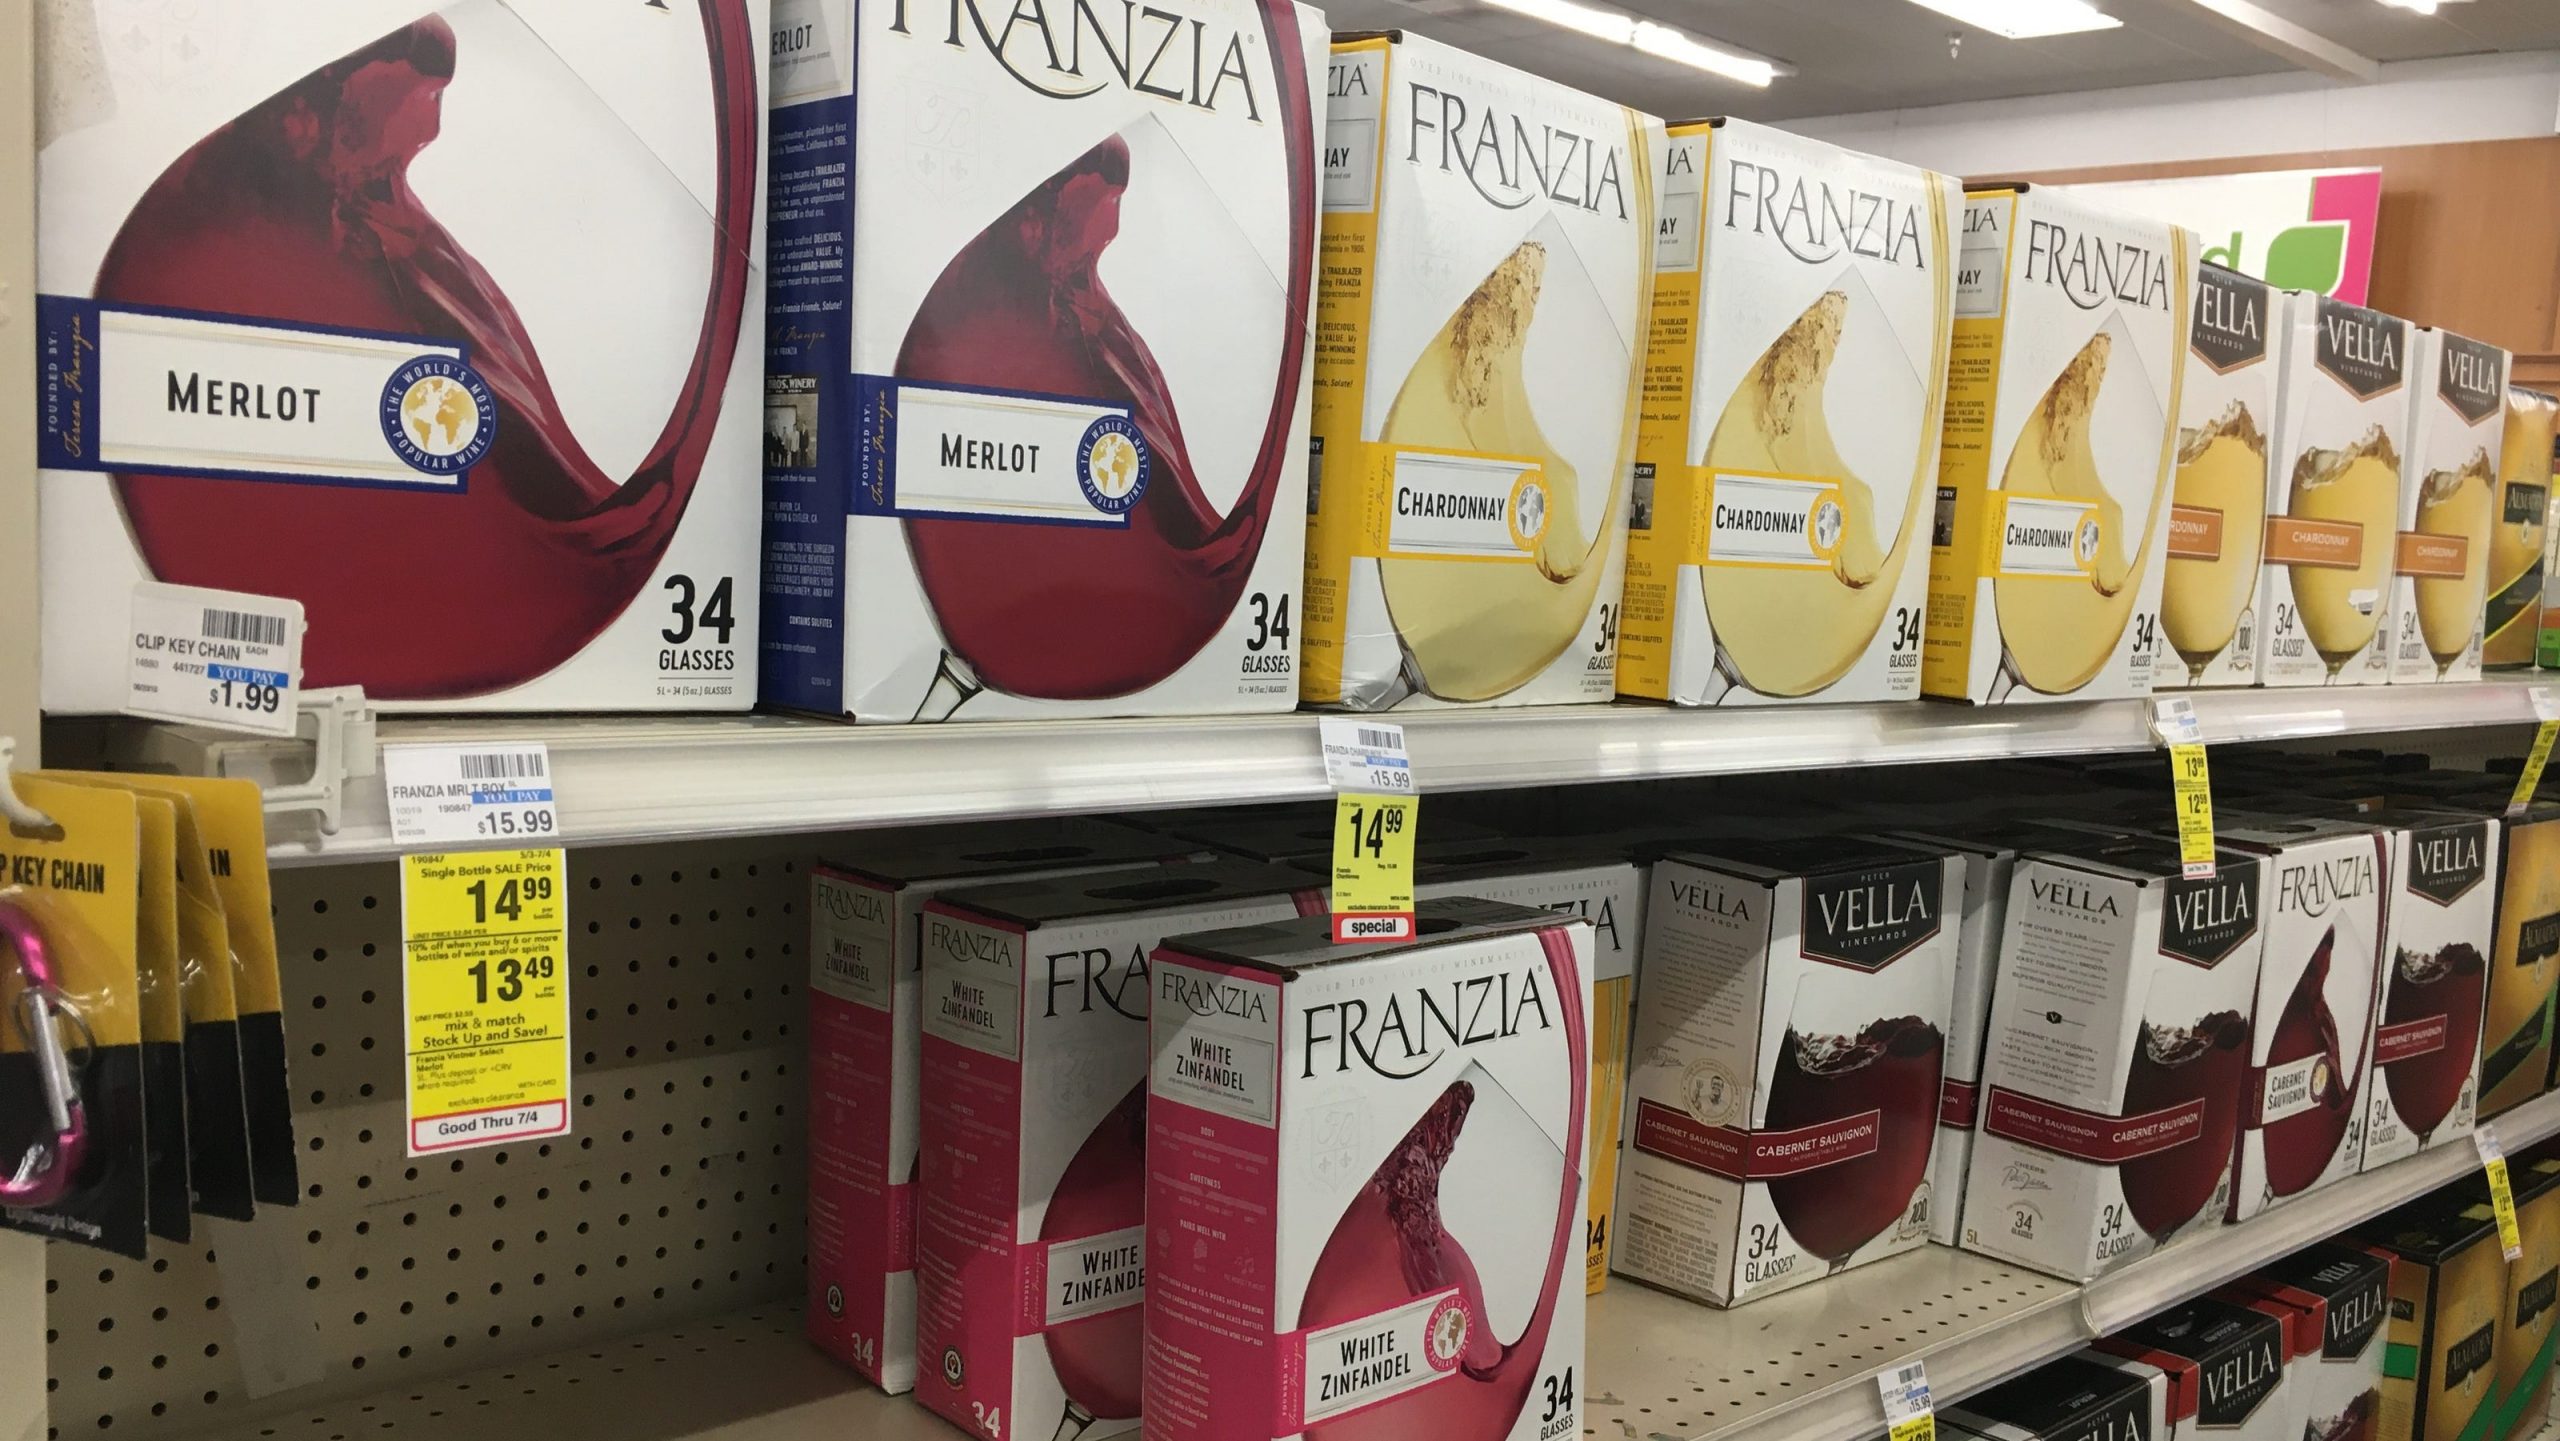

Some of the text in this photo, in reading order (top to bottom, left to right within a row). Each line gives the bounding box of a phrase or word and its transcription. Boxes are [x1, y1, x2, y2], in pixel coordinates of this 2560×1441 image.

[772, 24, 812, 55] ERLOT
[1406, 81, 1629, 221] FRANZIA
[1724, 159, 1925, 269] FRANZIA
[2025, 219, 2169, 311] FRANZIA
[2199, 284, 2257, 339] ELLA
[2327, 315, 2395, 369] VELLA
[789, 378, 817, 389] WINERY
[2448, 348, 2495, 397] VELLA
[168, 370, 321, 424] MERLOT
[387, 363, 491, 421] THE WORLD'S MOST
[393, 431, 485, 468] POPULAR WINE
[941, 433, 1039, 473] MERLOT
[1081, 442, 1092, 464] THE
[1134, 438, 1147, 469] MOST
[1084, 478, 1142, 509] POPULAR WINE
[1398, 486, 1506, 521] CHARDONNAY
[1716, 504, 1806, 534] CHARDONNAY
[2007, 524, 2073, 549] CHARDONNAY
[2292, 531, 2349, 546] CHARDONNAY
[661, 574, 735, 644] 34
[1246, 592, 1290, 651] 34
[2275, 603, 2293, 636] 34
[1595, 603, 1618, 652] 34
[1893, 607, 1920, 651] 34
[2133, 613, 2155, 652] 34
[2402, 612, 2415, 639] 34
[136, 633, 240, 661] CLIP KEY CHAIN
[659, 650, 734, 670] GLASSES
[1889, 654, 1917, 668] GLASSES
[217, 666, 277, 685] YOU PAY
[1241, 655, 1290, 673] GLASSES
[210, 680, 279, 713] $1.99
[393, 783, 505, 798] FRANZIA MRLT BOX
[483, 790, 541, 803] YOU PAY
[477, 809, 553, 834] $15.99
[411, 855, 444, 864] 190847
[421, 863, 552, 880] Single Bottle SALE Price
[2418, 836, 2479, 875] VELLA
[12, 855, 46, 886] KEY
[51, 859, 104, 893] CHAIN
[1861, 871, 1890, 882] PETER
[2278, 855, 2374, 918] FRANZIA
[817, 883, 885, 925] FRANZIA
[1670, 880, 1749, 922] VELLA
[1818, 879, 1928, 935] VELLA
[2031, 878, 2118, 918] VELLA
[2175, 882, 2248, 933] VELLA
[1351, 918, 1397, 936] special
[2036, 904, 2106, 925] VINEYARDS
[416, 951, 448, 961] bottles
[451, 950, 461, 959] of
[464, 949, 486, 958] wine
[521, 944, 550, 954] spirits
[431, 941, 443, 950] off
[446, 940, 471, 949] when
[474, 940, 491, 949] you
[493, 936, 510, 946] buy
[534, 935, 558, 943] more
[834, 937, 861, 961] WHITE
[931, 922, 1013, 968] FRANZIA
[1839, 929, 1907, 949] VINEYARDS
[825, 953, 870, 982] ZINFANDEL
[952, 979, 984, 1006] WHITE
[1161, 971, 1267, 1023] FRANZIA
[445, 1013, 525, 1032] mix & match
[941, 996, 995, 1029] ZINFANDEL
[1301, 967, 1551, 1080] FRANZIA
[423, 1025, 548, 1048] Stock Up and Save!
[1190, 1036, 1231, 1066] WHITE
[2380, 1033, 2412, 1047] CABERNET
[416, 1052, 445, 1063] Franzia
[416, 1063, 443, 1072] Merlot
[1176, 1055, 1245, 1092] ZINFANDEL
[2272, 1070, 2306, 1092] CABERNET
[2268, 1086, 2306, 1110] SAUVIGNON
[2373, 1099, 2388, 1127] 34
[438, 1111, 538, 1136] Good Thru 7/4
[1645, 1119, 1738, 1154] CABERNET SAUVIGNON
[1997, 1104, 2098, 1139] CABERNET SAUVIGNON
[2112, 1111, 2199, 1144] CABERNET SAUVIGNON
[2346, 1118, 2362, 1150] 34
[1756, 1124, 1872, 1157] CABERNET SAUVIGNON
[1909, 1198, 1927, 1224] 100
[2014, 1211, 2032, 1231] 34
[2100, 1203, 2124, 1238] 34
[1180, 1219, 1195, 1231] PAIRS
[1197, 1224, 1211, 1236] WELL
[1748, 1223, 1780, 1260] 34
[1966, 1229, 1979, 1245] 5L
[1083, 1245, 1138, 1276] WHITE
[1745, 1254, 1796, 1283] GLASSES
[2313, 1261, 2359, 1284] VELLA
[1062, 1268, 1145, 1306] ZINFANDE
[2331, 1284, 2382, 1342] VELLA
[851, 1332, 873, 1366] 34
[1340, 1330, 1395, 1366] WHITE
[1320, 1352, 1411, 1401] ZINFANDEL
[2207, 1341, 2274, 1405] VELLA
[1541, 1366, 1573, 1422] 34
[972, 1400, 1001, 1438] 34
[1540, 1413, 1574, 1441] GLASSES
